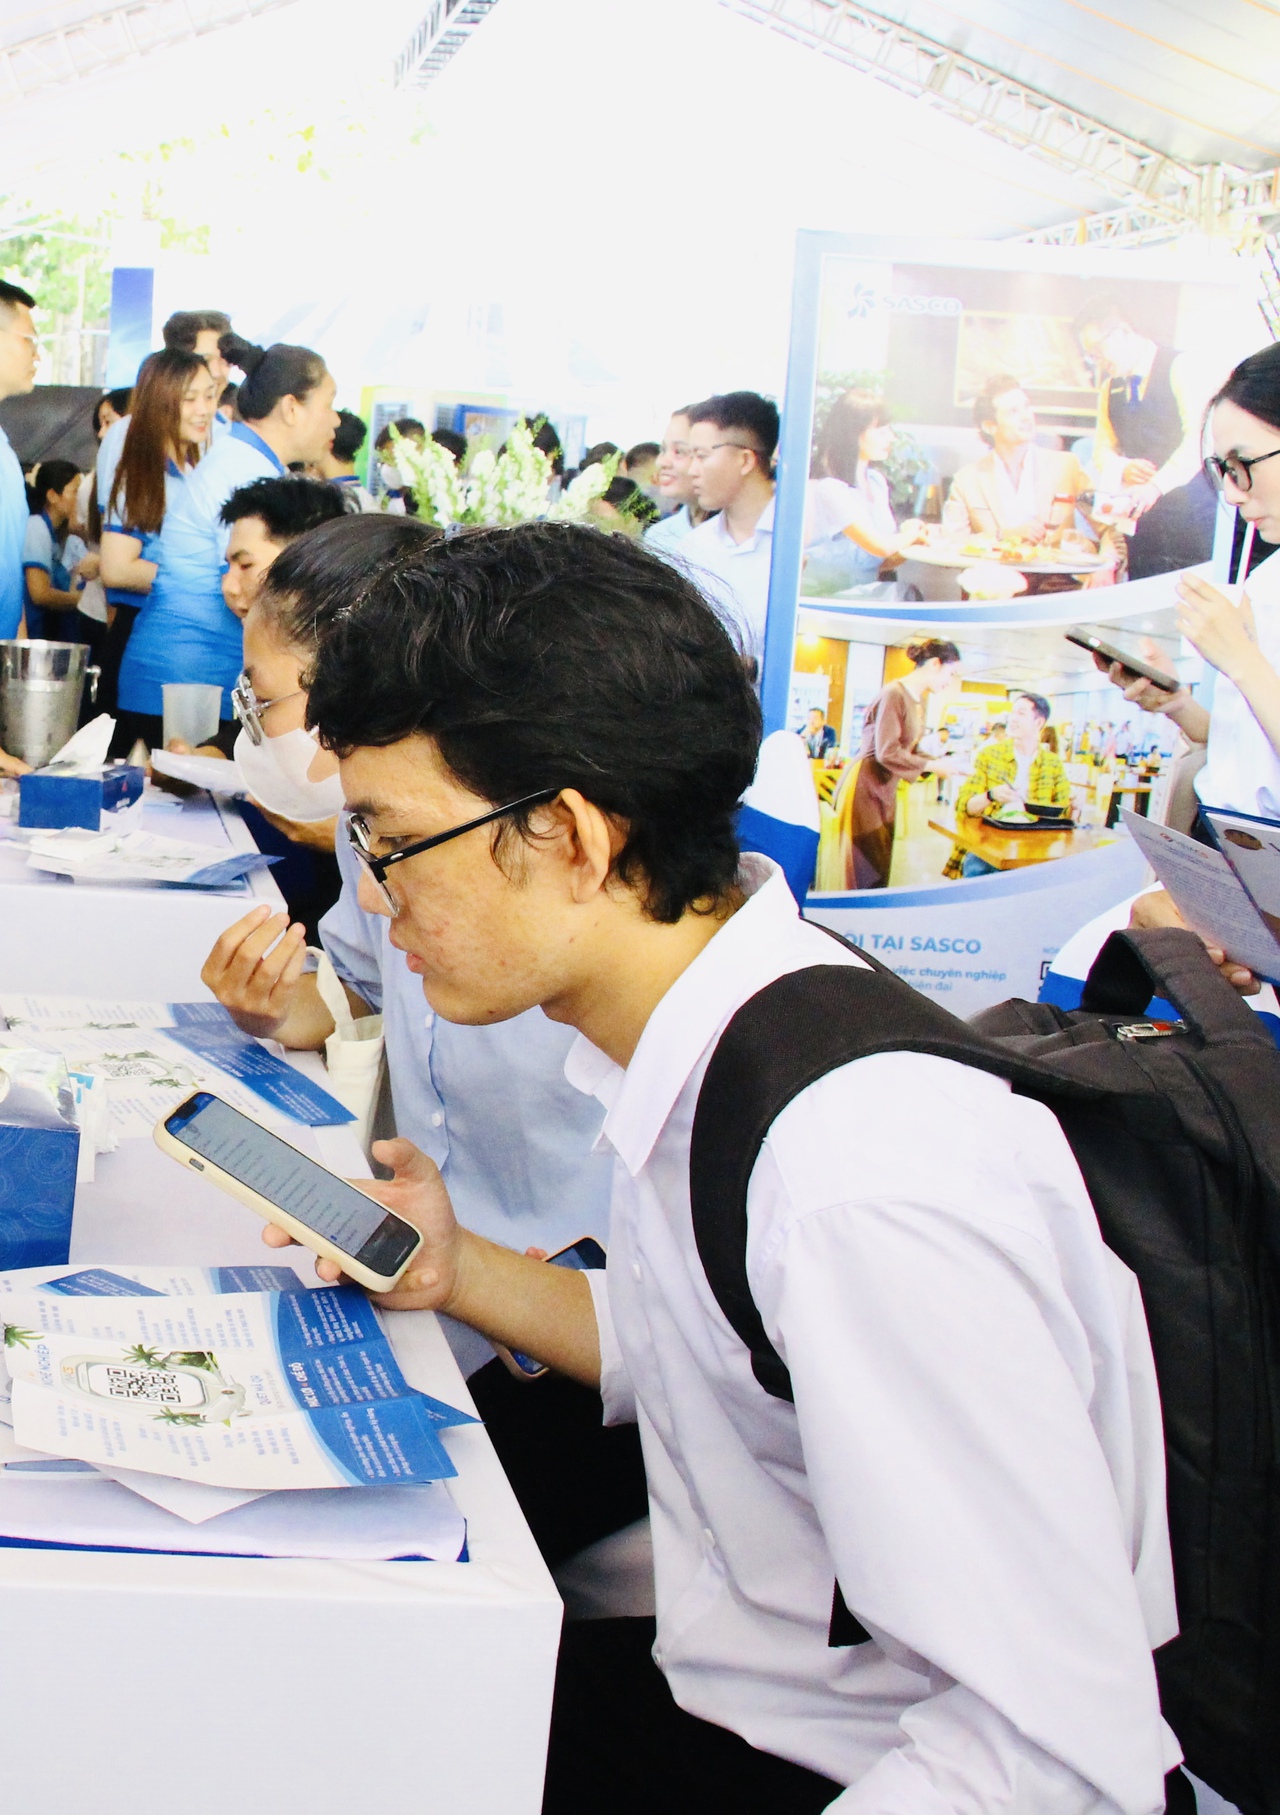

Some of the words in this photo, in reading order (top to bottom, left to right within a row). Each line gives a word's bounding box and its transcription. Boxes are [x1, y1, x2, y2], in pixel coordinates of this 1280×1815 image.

[882, 294, 961, 314] SASCO
[870, 933, 904, 953] TẠI
[910, 935, 982, 955] SASCO
[919, 967, 962, 979] chuyên
[966, 970, 1007, 982] nghiệp
